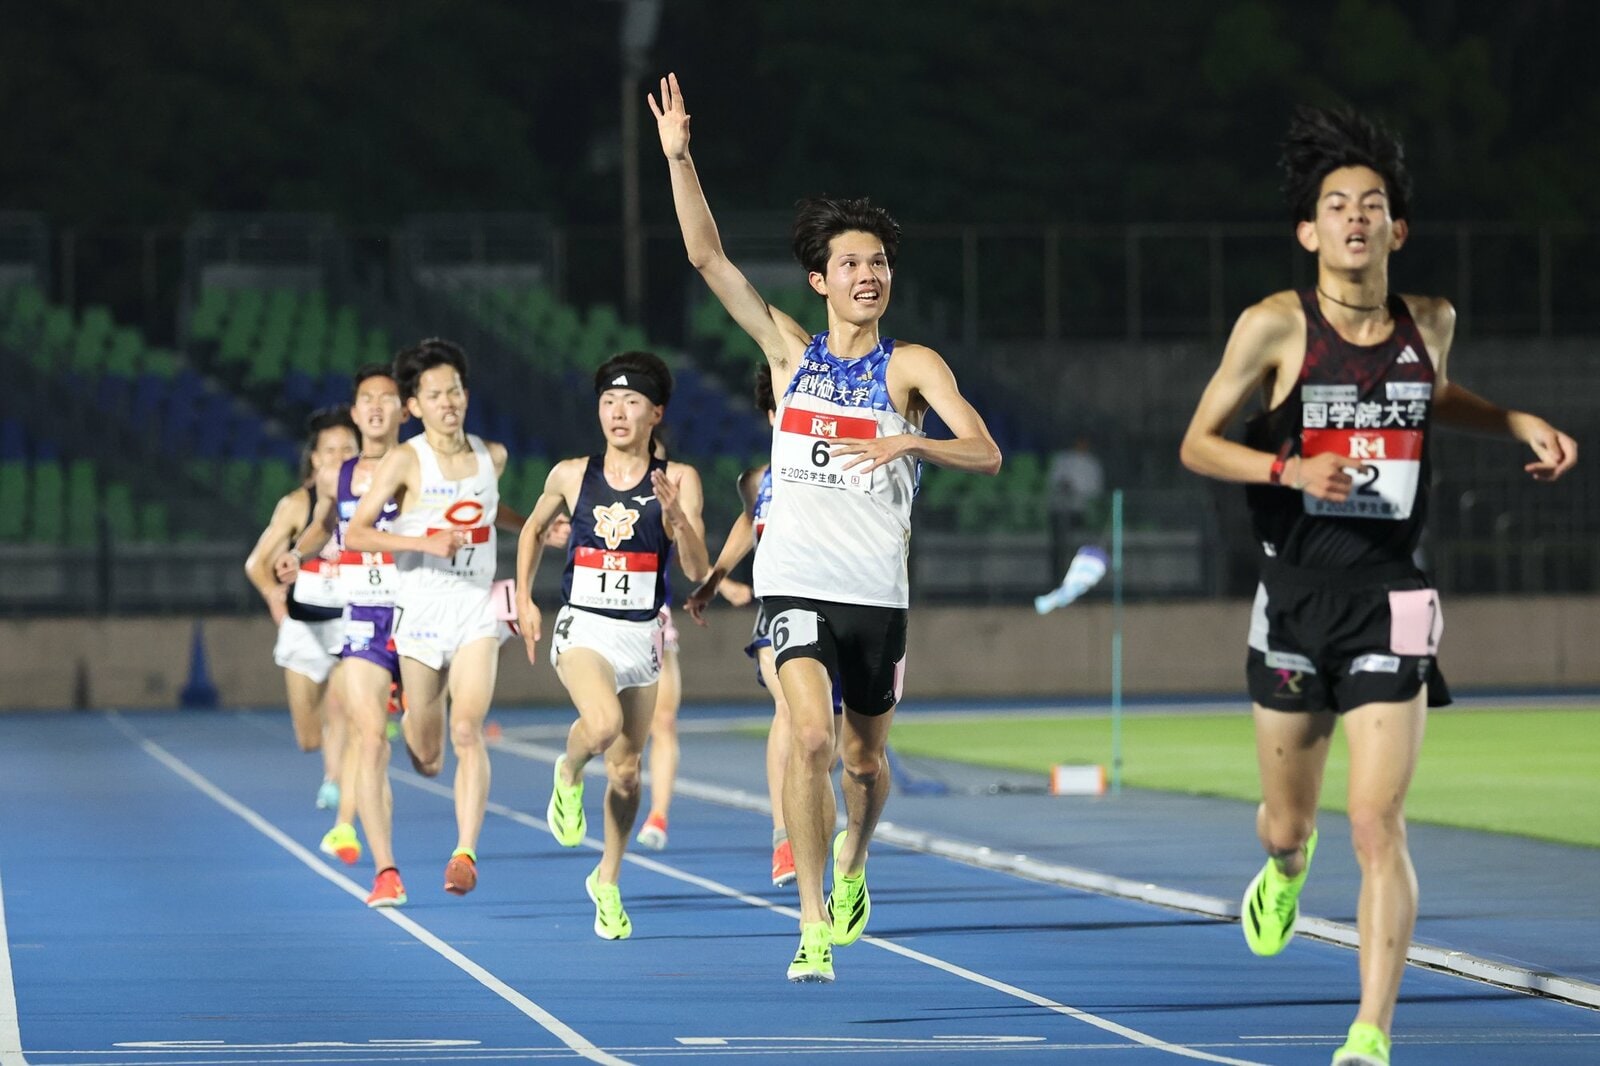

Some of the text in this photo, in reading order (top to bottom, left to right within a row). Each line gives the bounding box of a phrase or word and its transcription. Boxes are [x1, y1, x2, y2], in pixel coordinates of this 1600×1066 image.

[796, 373, 869, 406] 創価大学
[1303, 400, 1426, 429] 国学院大学
[811, 440, 830, 467] 6
[1356, 464, 1380, 496] 2
[369, 569, 382, 586] 8
[597, 572, 631, 595] 14
[556, 616, 575, 640] 4
[772, 616, 790, 651] 6
